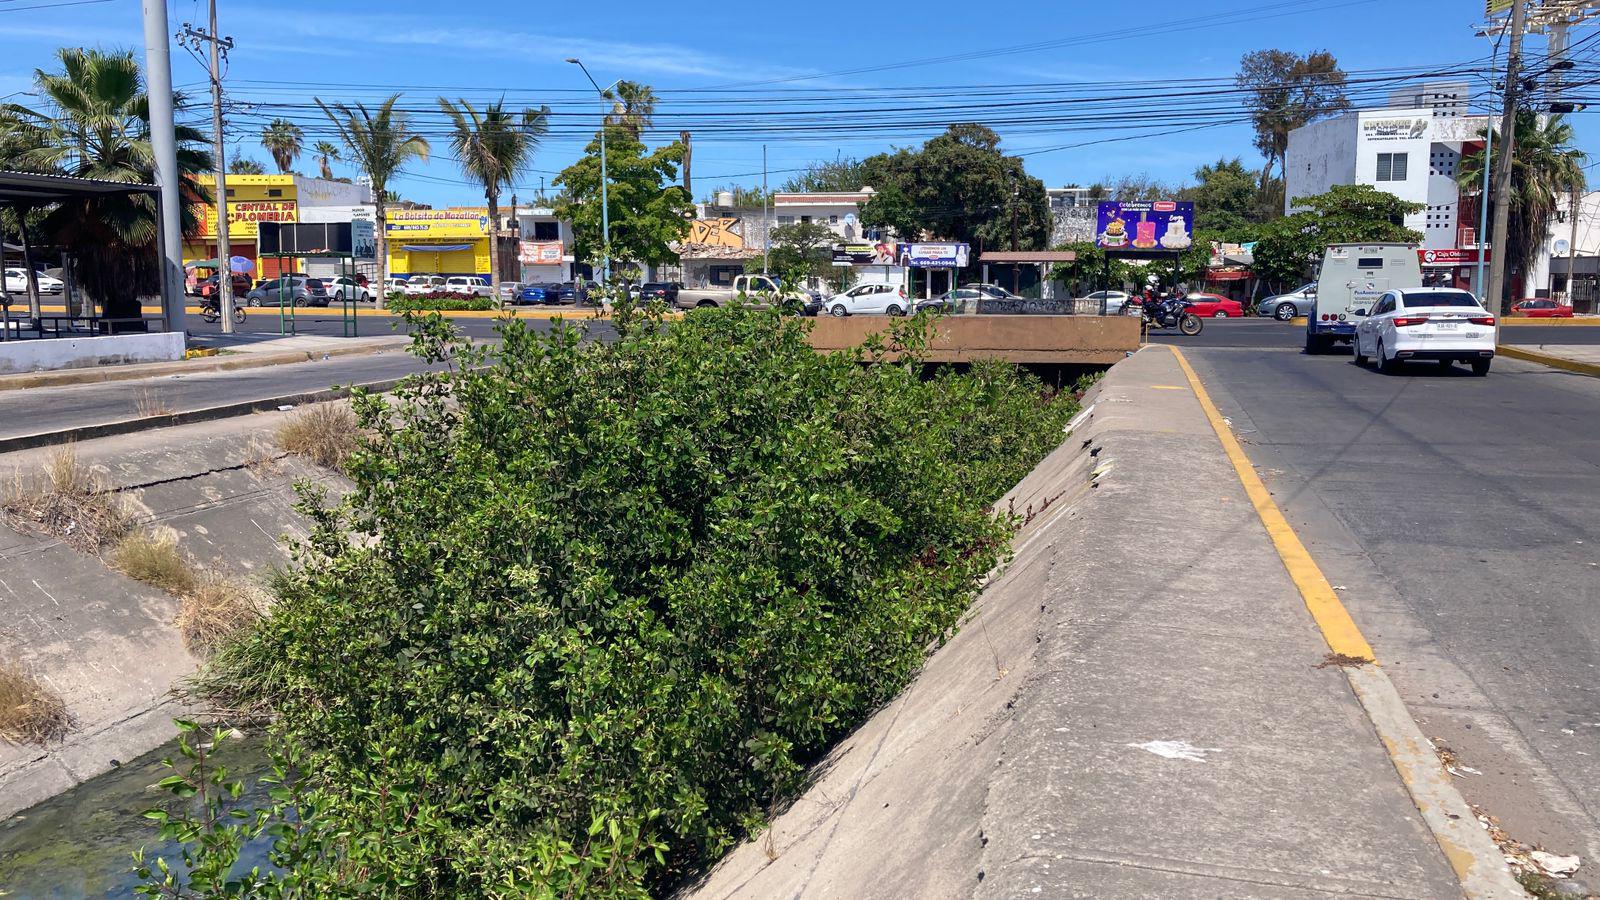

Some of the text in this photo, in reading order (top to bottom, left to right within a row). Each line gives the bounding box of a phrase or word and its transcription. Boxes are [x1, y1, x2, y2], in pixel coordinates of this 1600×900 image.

[235, 202, 295, 212] CENTRAL DE
[394, 213, 404, 221] La
[404, 212, 433, 221] Bolsita
[434, 212, 444, 220] de
